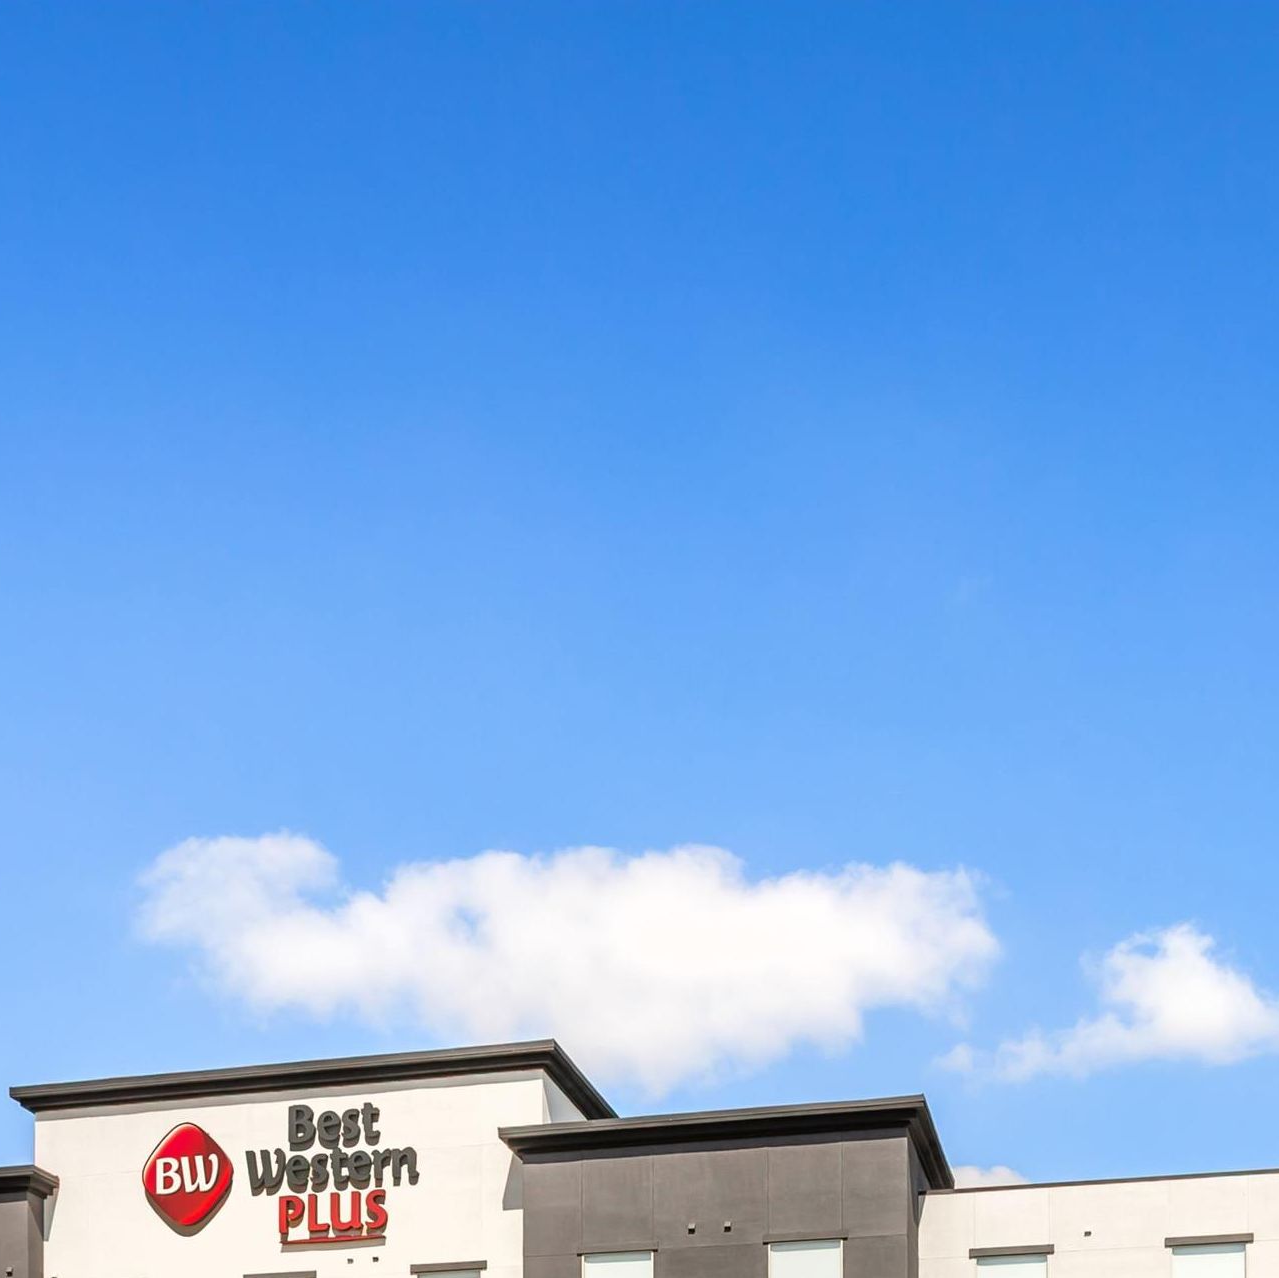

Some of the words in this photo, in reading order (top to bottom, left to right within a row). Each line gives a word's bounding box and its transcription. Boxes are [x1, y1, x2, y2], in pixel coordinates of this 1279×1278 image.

[288, 1102, 380, 1147] Best
[155, 1154, 219, 1195] BW
[245, 1147, 419, 1195] Western
[278, 1189, 388, 1234] PLUS
